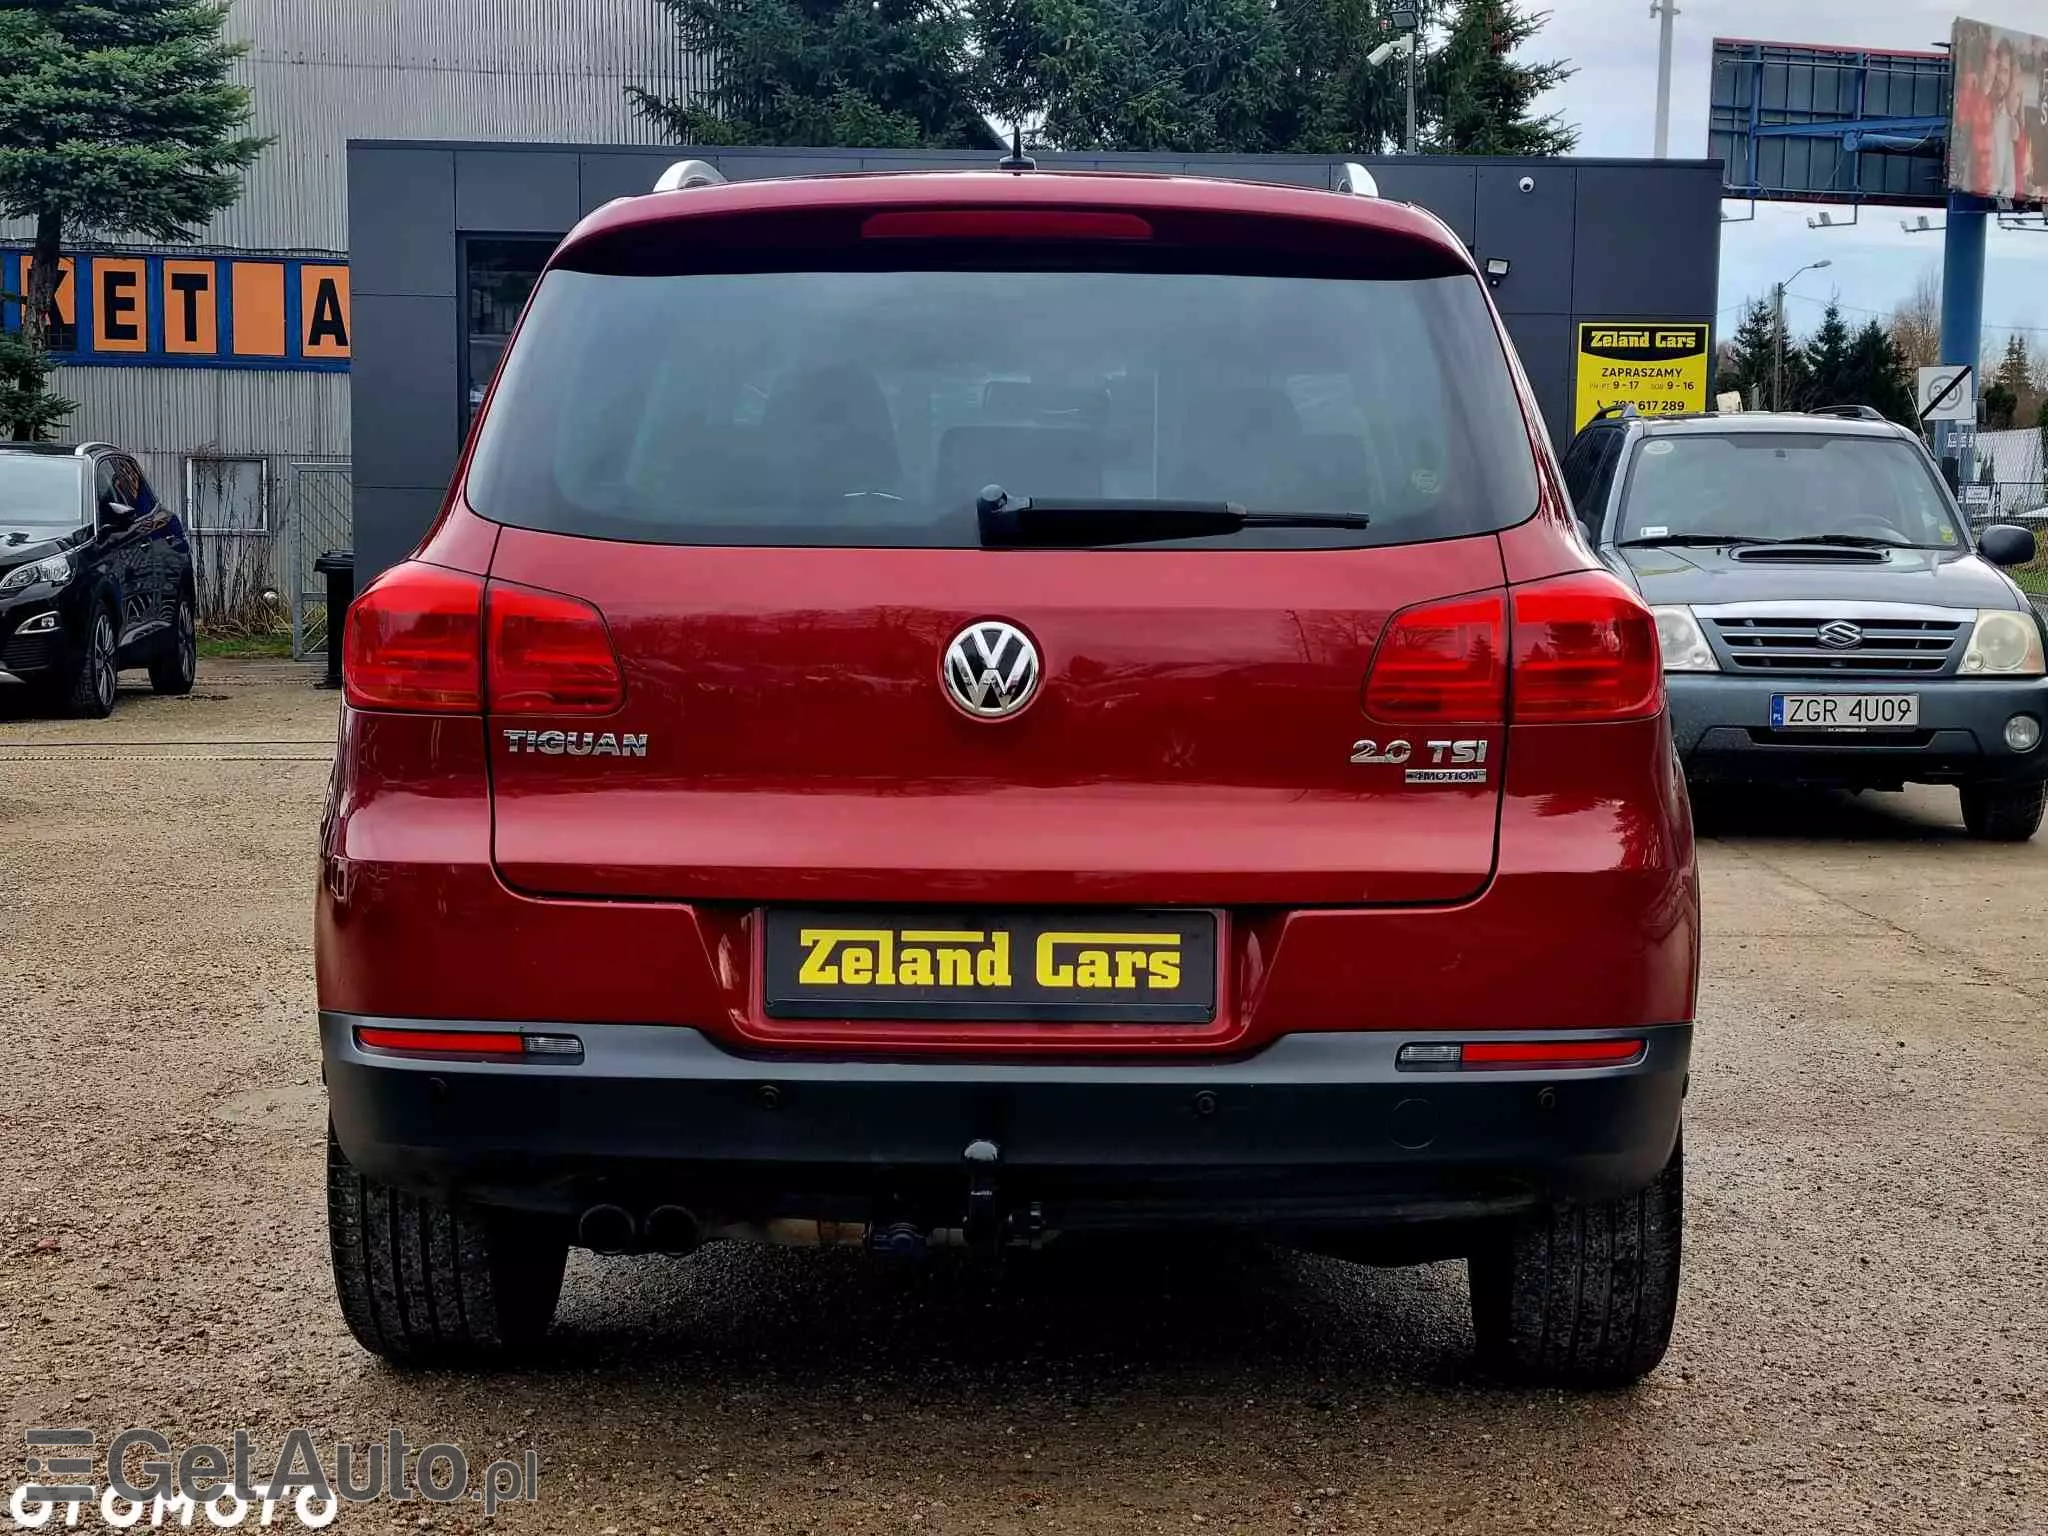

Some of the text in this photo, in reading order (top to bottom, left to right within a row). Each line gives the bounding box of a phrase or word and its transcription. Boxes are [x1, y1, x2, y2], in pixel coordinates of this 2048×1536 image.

[1591, 331, 1696, 348] Zeland Cars
[1601, 367, 1683, 378] ZAPRASZAMY
[1629, 381, 1640, 390] 17
[1683, 381, 1695, 390] 16
[1638, 400, 1659, 411] 617
[1662, 400, 1685, 411] 289
[1788, 699, 1912, 723] ZGR 4U09
[503, 729, 649, 757] TIGUAN
[1350, 739, 1488, 763] 2.0 TSI
[799, 928, 1182, 989] Zeland Cars
